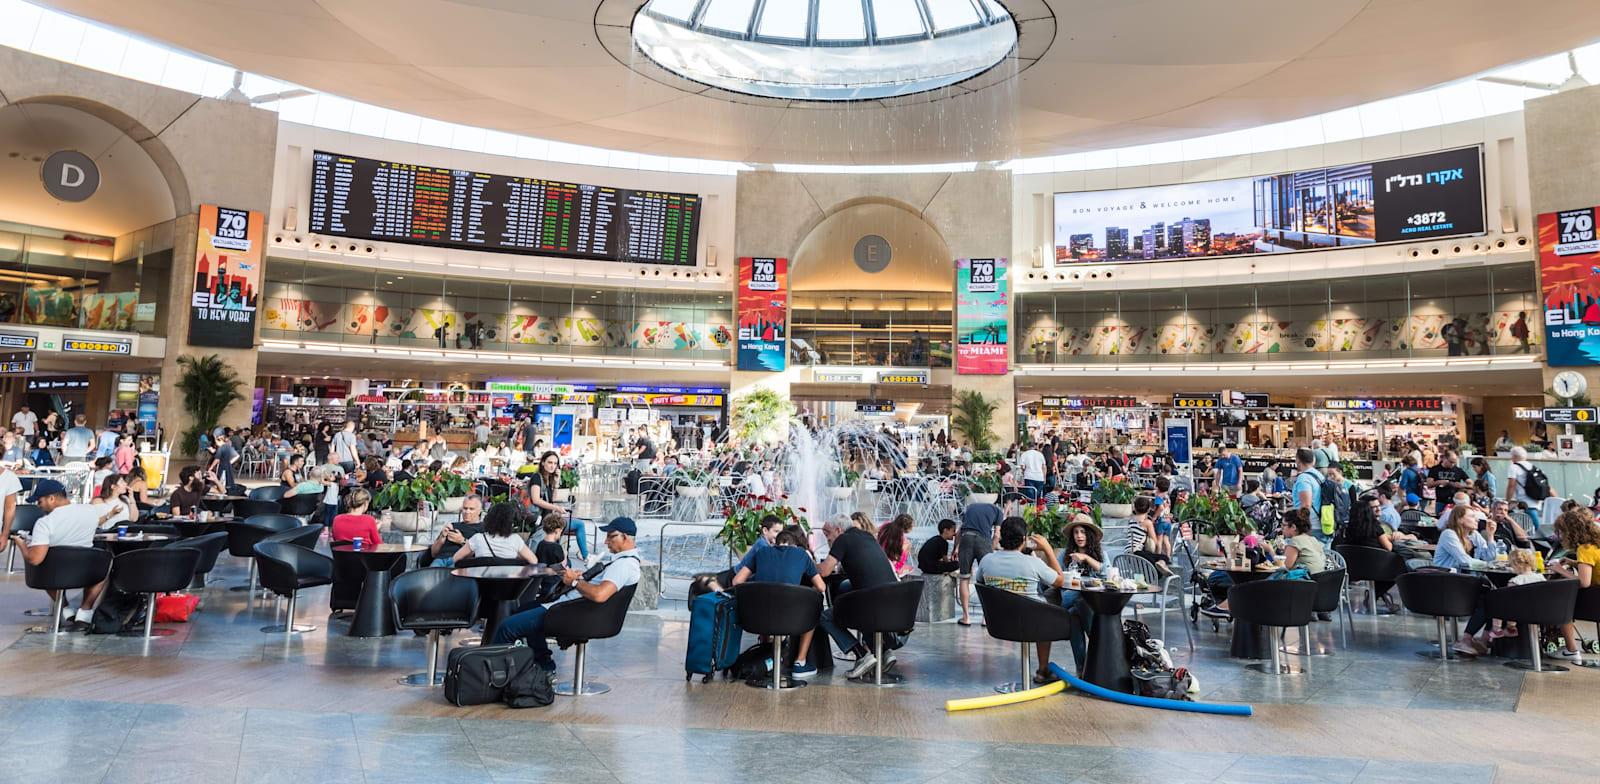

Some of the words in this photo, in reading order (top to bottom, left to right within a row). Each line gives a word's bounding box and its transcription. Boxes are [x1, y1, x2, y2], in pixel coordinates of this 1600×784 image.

[61, 163, 85, 187] D
[1426, 168, 1464, 185] אקרו
[1097, 204, 1134, 213] VOYAGE
[1152, 199, 1201, 208] WELCOME
[1207, 196, 1236, 204] HOME
[220, 213, 247, 230] 70
[1432, 223, 1454, 231] ESTATE
[1560, 215, 1593, 233] 70
[219, 227, 246, 239] שנה
[1562, 230, 1593, 243] שנה
[867, 244, 878, 262] E
[753, 262, 775, 274] 70
[972, 263, 993, 276] 70
[753, 273, 774, 282] שנה
[972, 275, 993, 283] שנה
[198, 308, 207, 320] TO
[209, 309, 227, 321] NEW
[228, 310, 250, 323] YORK
[1561, 329, 1586, 338] Hong
[747, 343, 763, 351] Hong
[970, 347, 1004, 355] MIAMI
[653, 396, 669, 405] DUTY
[1083, 399, 1108, 407] DUTY
[1110, 399, 1136, 407] FREE
[1375, 400, 1405, 409] DUTY
[1408, 400, 1440, 409] FREE
